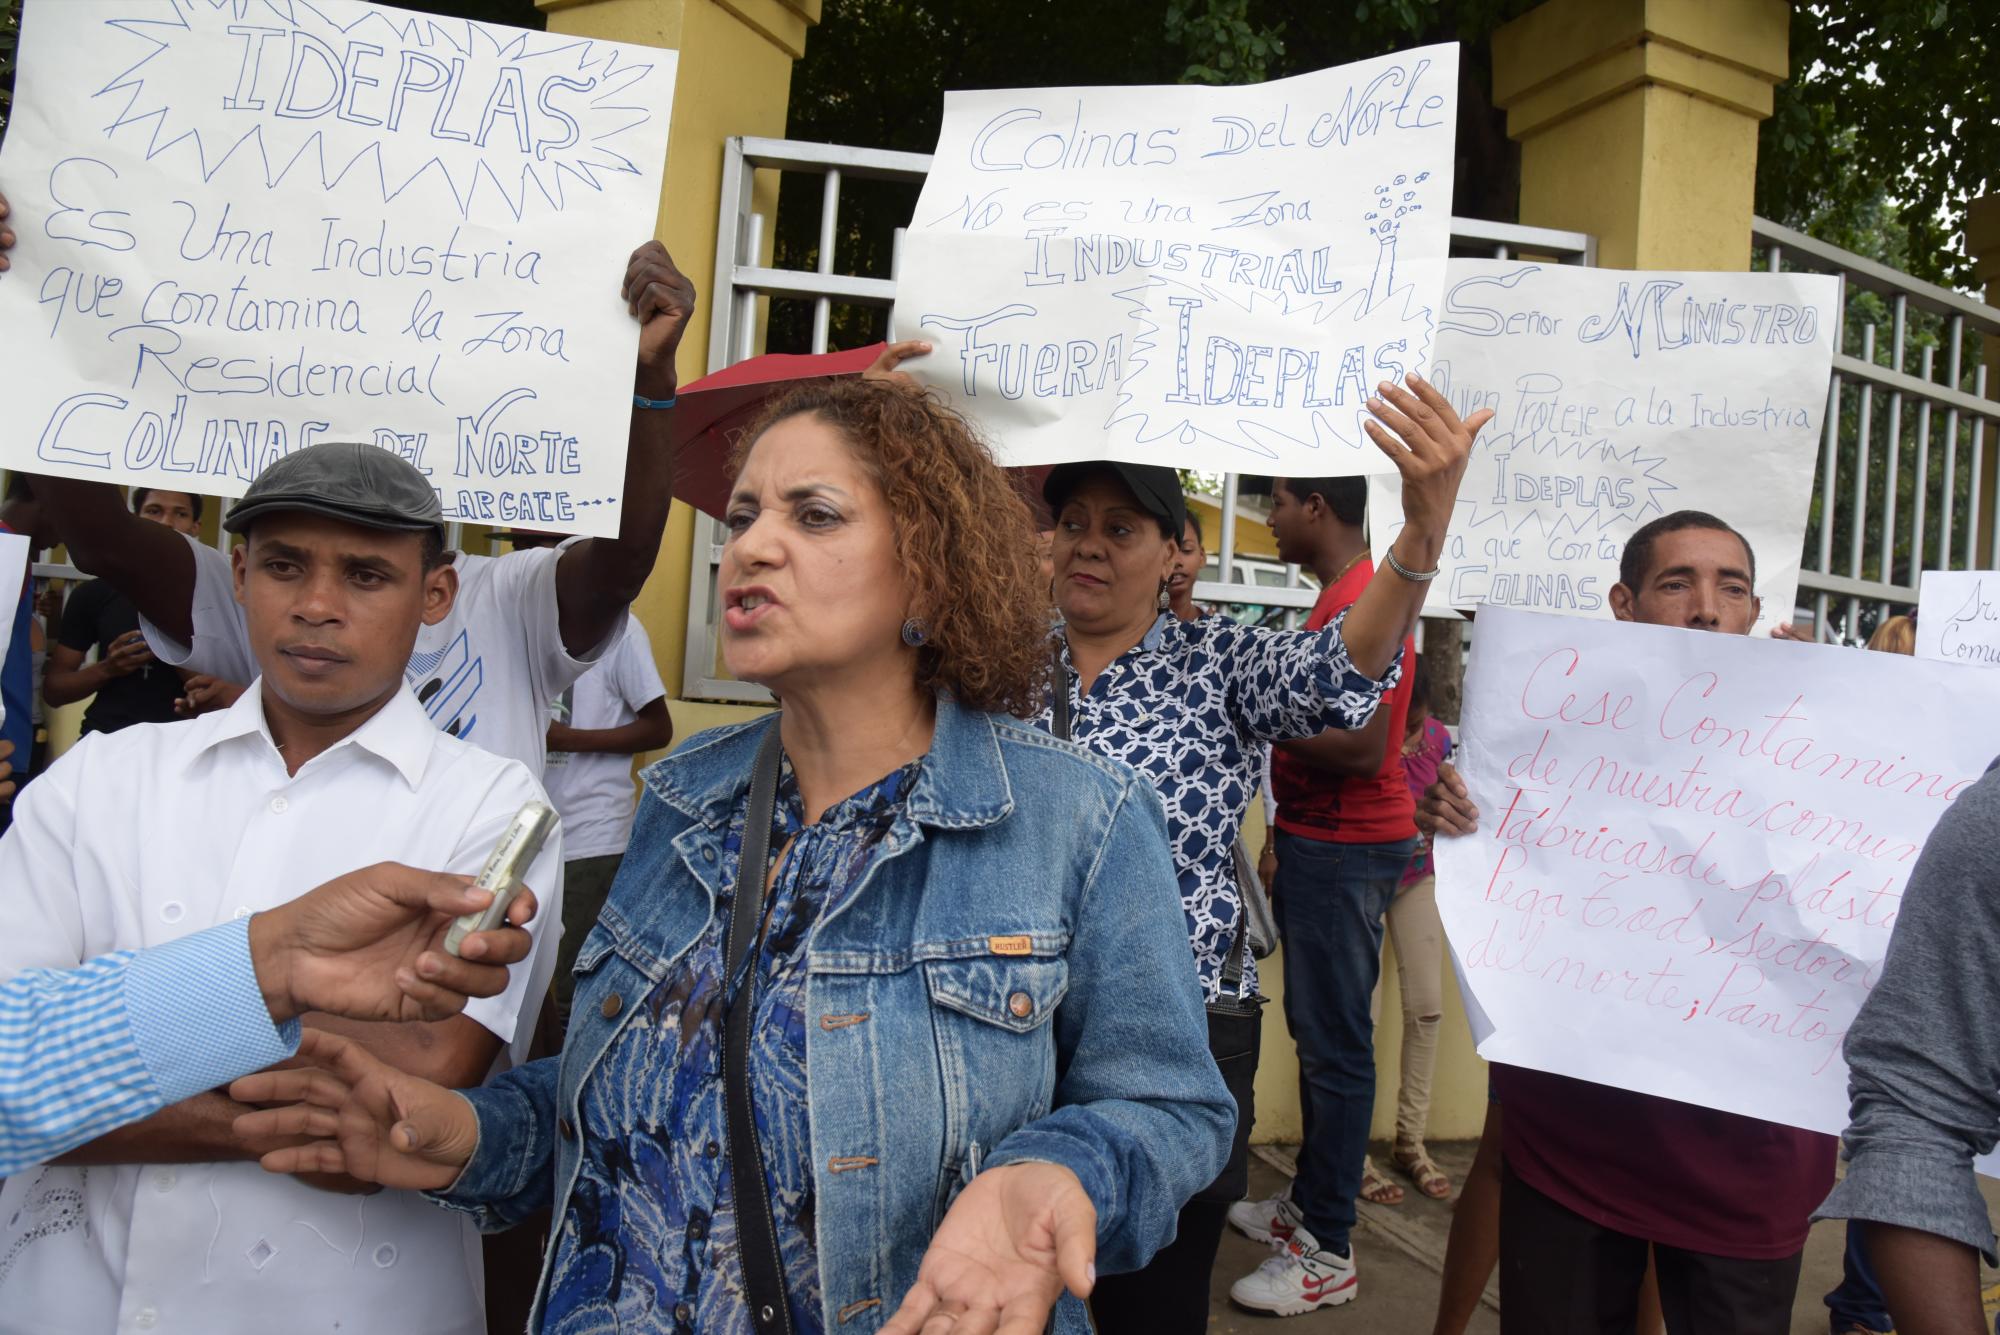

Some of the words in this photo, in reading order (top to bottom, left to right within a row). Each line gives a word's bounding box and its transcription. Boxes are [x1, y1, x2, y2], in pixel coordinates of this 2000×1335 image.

[223, 25, 596, 161] IDEPLAS
[970, 99, 1180, 171] Colinas
[1200, 104, 1296, 158] Del
[1308, 59, 1444, 148] Norte
[172, 200, 272, 268] Una
[311, 217, 542, 286] Industria
[927, 187, 1009, 231] No
[1211, 191, 1311, 231] Zona
[1024, 227, 1342, 294] INDUSTRIAL
[1437, 266, 1563, 337] Señor
[38, 266, 123, 339] que
[402, 289, 442, 342] la
[462, 311, 571, 362] Zona
[1166, 297, 1407, 408] IDEPLAS
[108, 325, 446, 406] Residencial
[36, 393, 330, 482] COLINA
[454, 388, 582, 478] NORTE
[1615, 397, 1636, 427] a
[1646, 386, 1675, 426] la
[1689, 393, 1812, 430] Industria
[1493, 453, 1635, 509] IDEPLAS
[1450, 565, 1601, 610] COLINAS
[1521, 647, 1638, 731] Cese
[1508, 729, 1561, 786] de
[1569, 755, 1751, 820] nuestra
